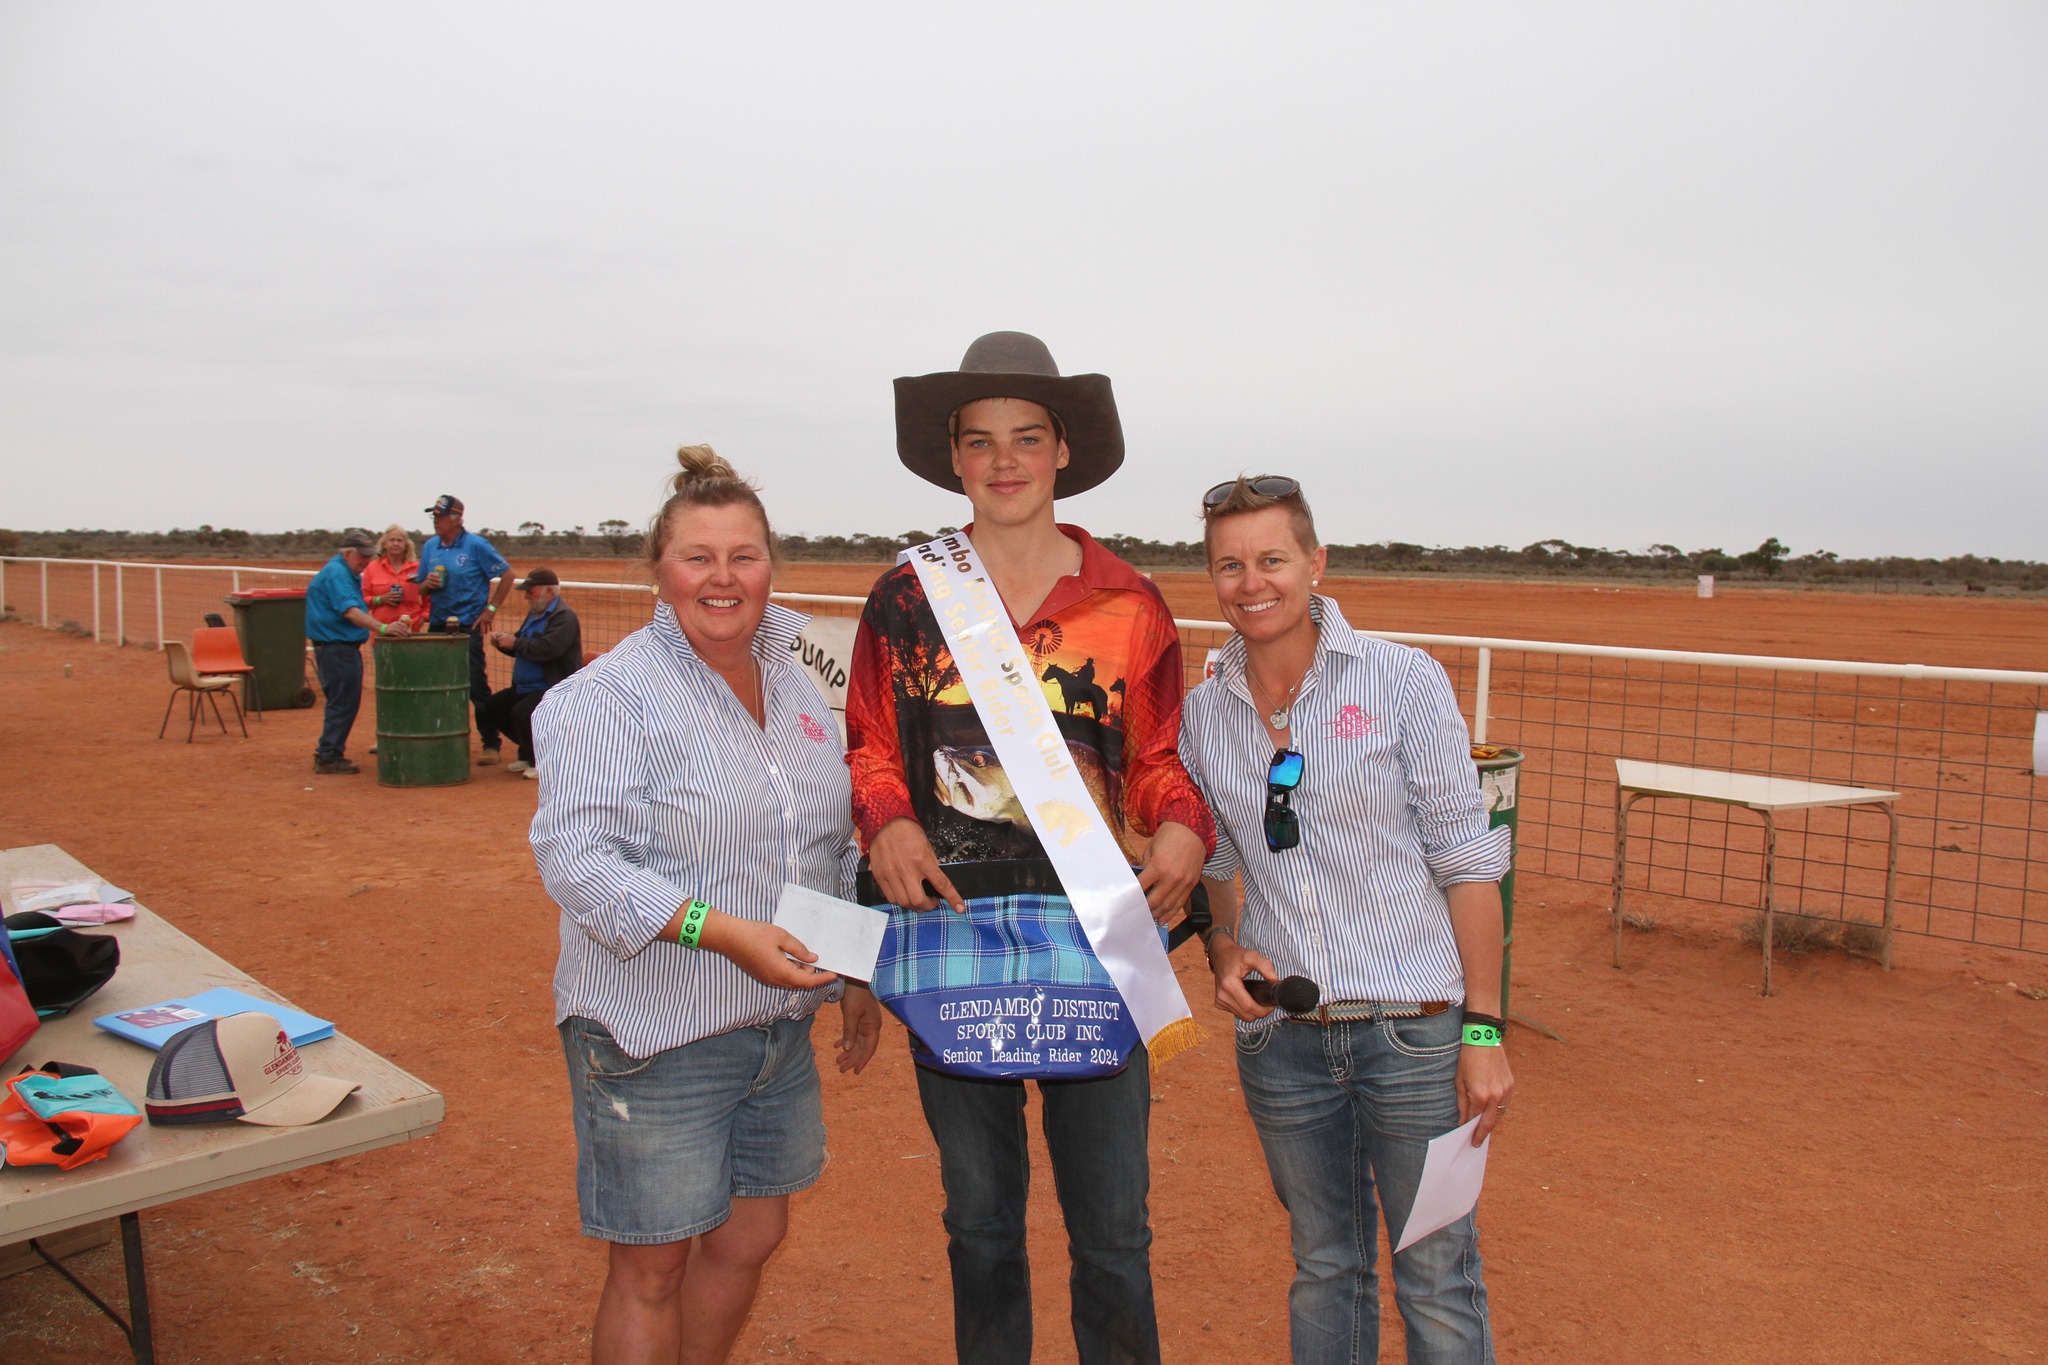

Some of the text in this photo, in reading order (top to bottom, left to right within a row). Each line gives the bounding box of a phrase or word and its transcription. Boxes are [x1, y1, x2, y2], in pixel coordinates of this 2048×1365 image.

[790, 636, 846, 688] DUMP
[944, 602, 986, 673] Senior
[978, 677, 1016, 736] Rider
[965, 577, 1011, 654] District
[1000, 657, 1044, 729] Sports
[1036, 733, 1070, 782] Club
[940, 997, 1119, 1021] GLENDAMBO DISTRICT
[957, 1023, 1104, 1041] SPORTS CLUB INC.
[943, 1046, 1119, 1066] Senior Leading Rider 2024
